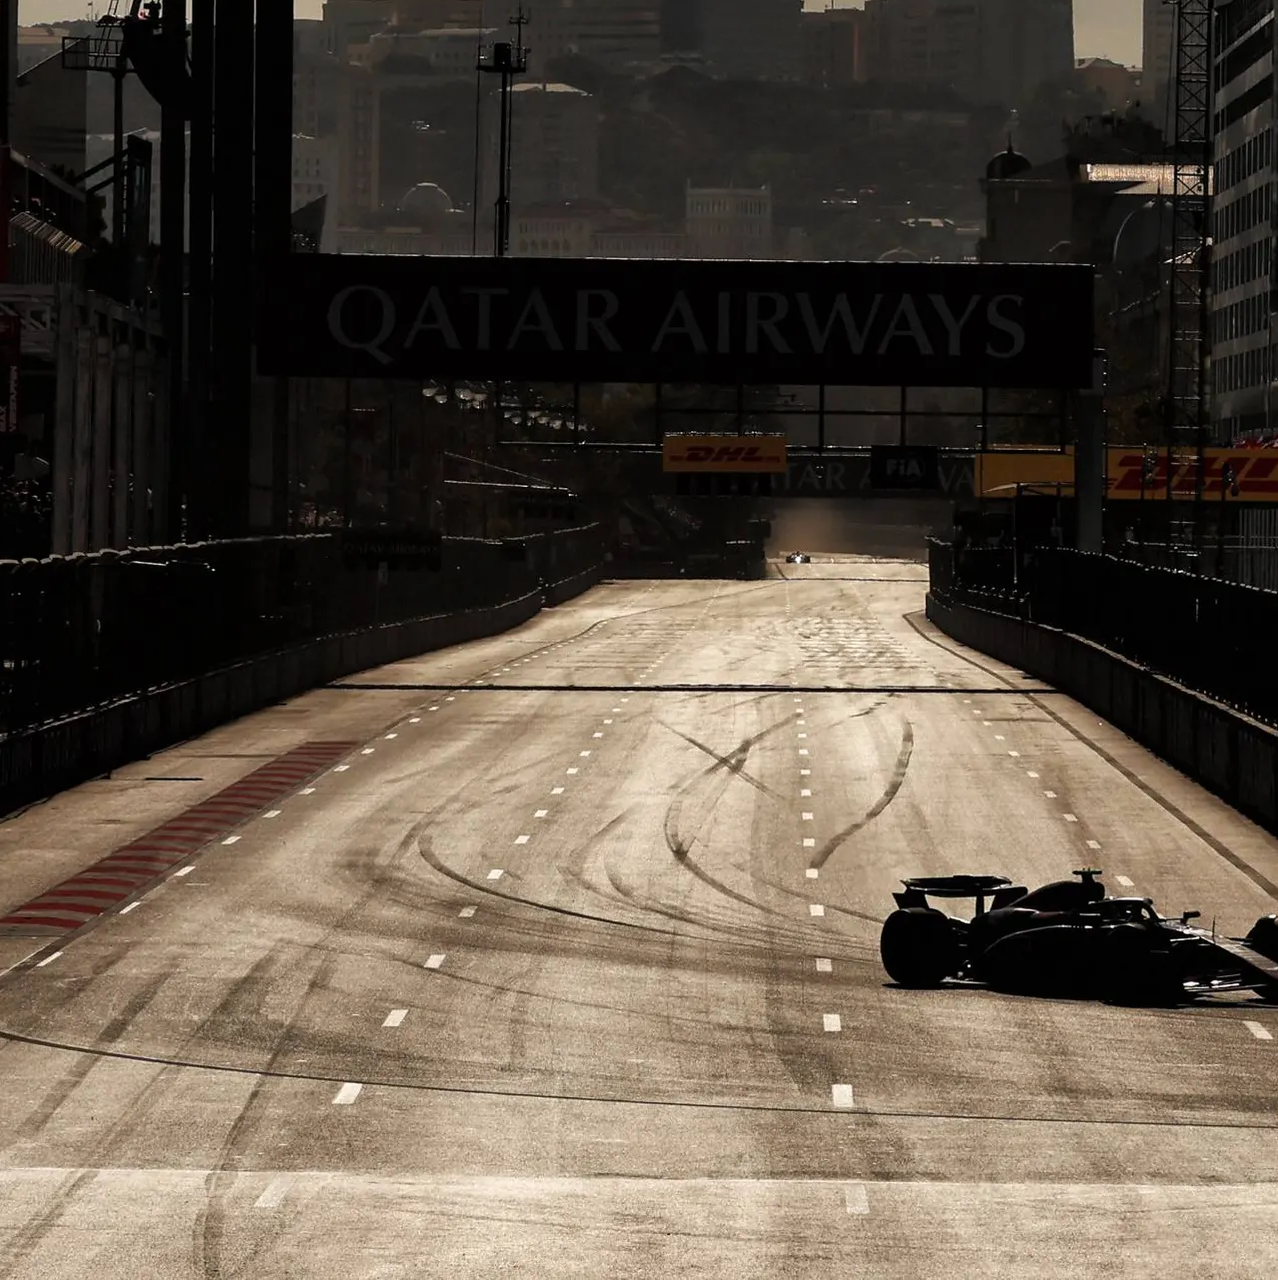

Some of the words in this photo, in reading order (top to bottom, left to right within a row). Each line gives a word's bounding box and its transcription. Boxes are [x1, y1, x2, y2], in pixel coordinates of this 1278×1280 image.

[326, 284, 623, 365] QATAR
[651, 288, 1027, 358] AIRWAYS
[685, 446, 764, 463] DHL
